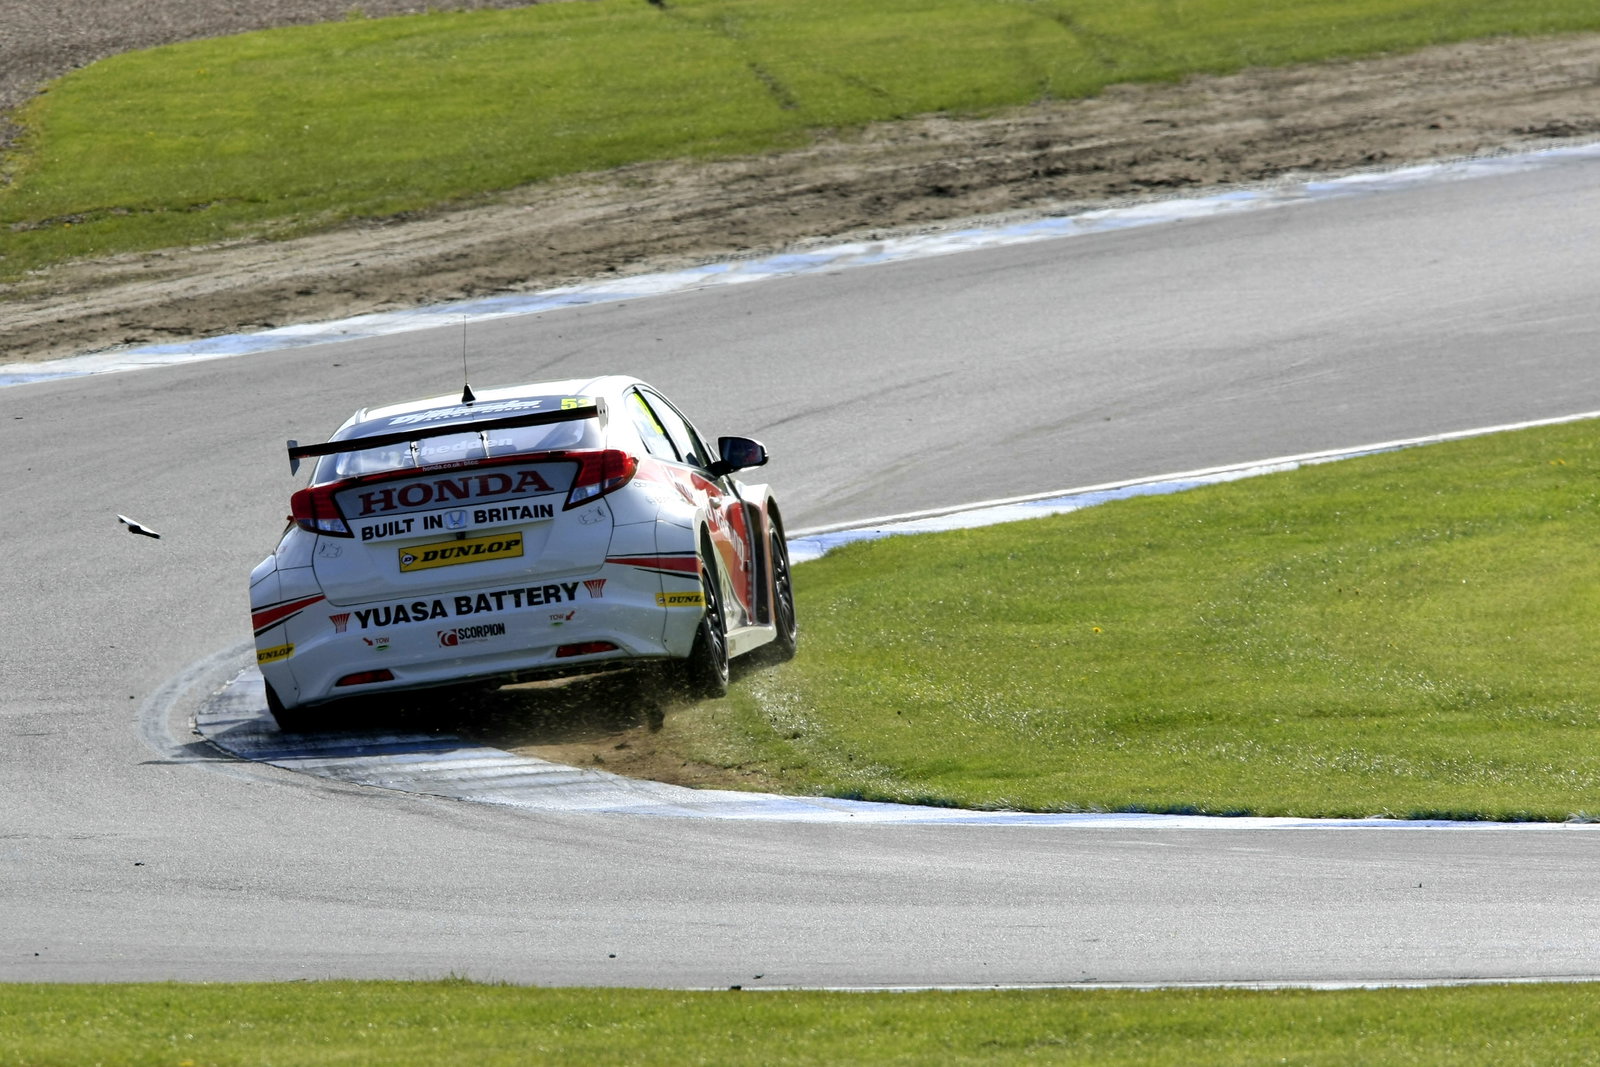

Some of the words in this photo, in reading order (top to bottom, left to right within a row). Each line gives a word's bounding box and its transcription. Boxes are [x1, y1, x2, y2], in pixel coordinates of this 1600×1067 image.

[358, 470, 554, 516] HONDA
[361, 518, 414, 541] BUILT
[423, 514, 443, 530] IN
[474, 504, 554, 524] BRITAIN
[421, 539, 521, 562] DUNLOP
[354, 600, 448, 629] YUASA
[455, 581, 580, 616] BATTERY
[668, 595, 703, 603] DUNL
[458, 622, 506, 640] SCORPION
[257, 646, 293, 661] UNLOP
